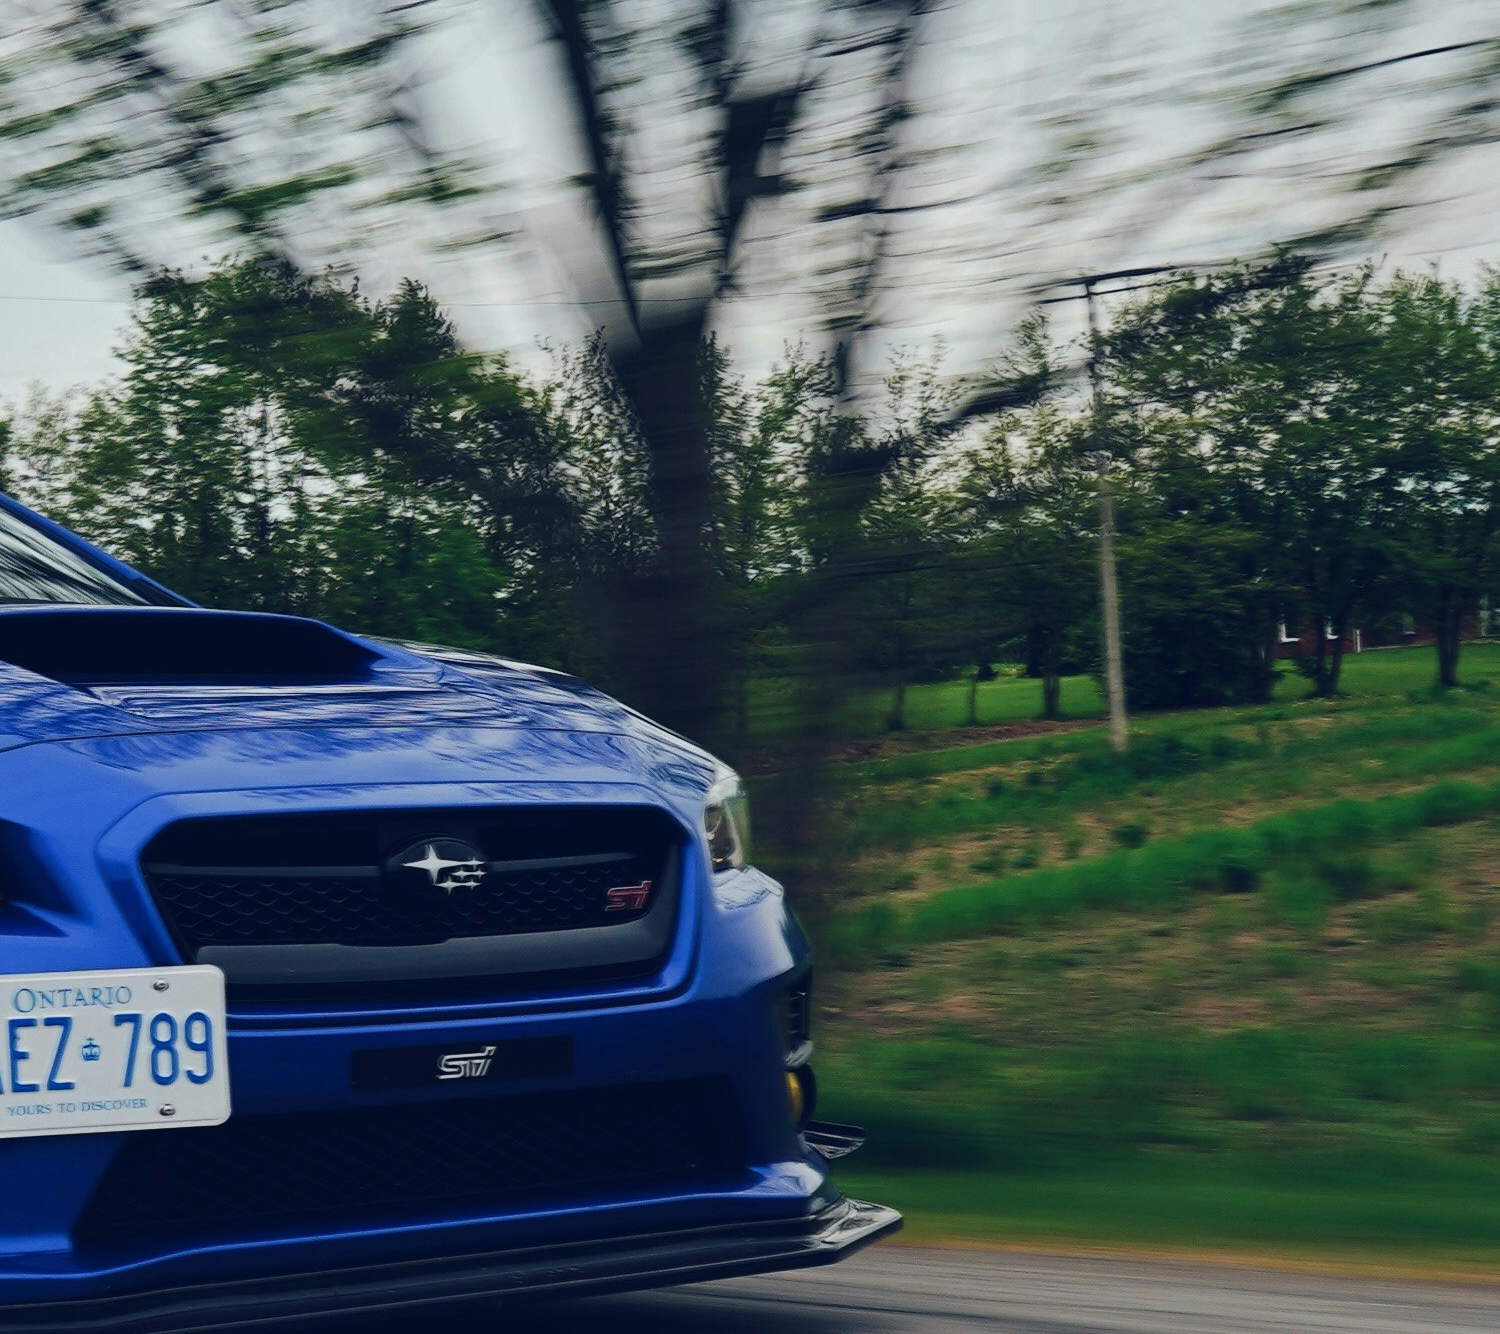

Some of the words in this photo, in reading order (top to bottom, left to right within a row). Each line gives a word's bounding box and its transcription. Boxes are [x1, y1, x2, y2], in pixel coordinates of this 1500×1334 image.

[13, 986, 132, 1013] ONTARIO
[114, 1011, 214, 1088] 789
[7, 1104, 52, 1116] YOURS
[58, 1103, 76, 1113] TO
[81, 1098, 147, 1112] DISCOVER
